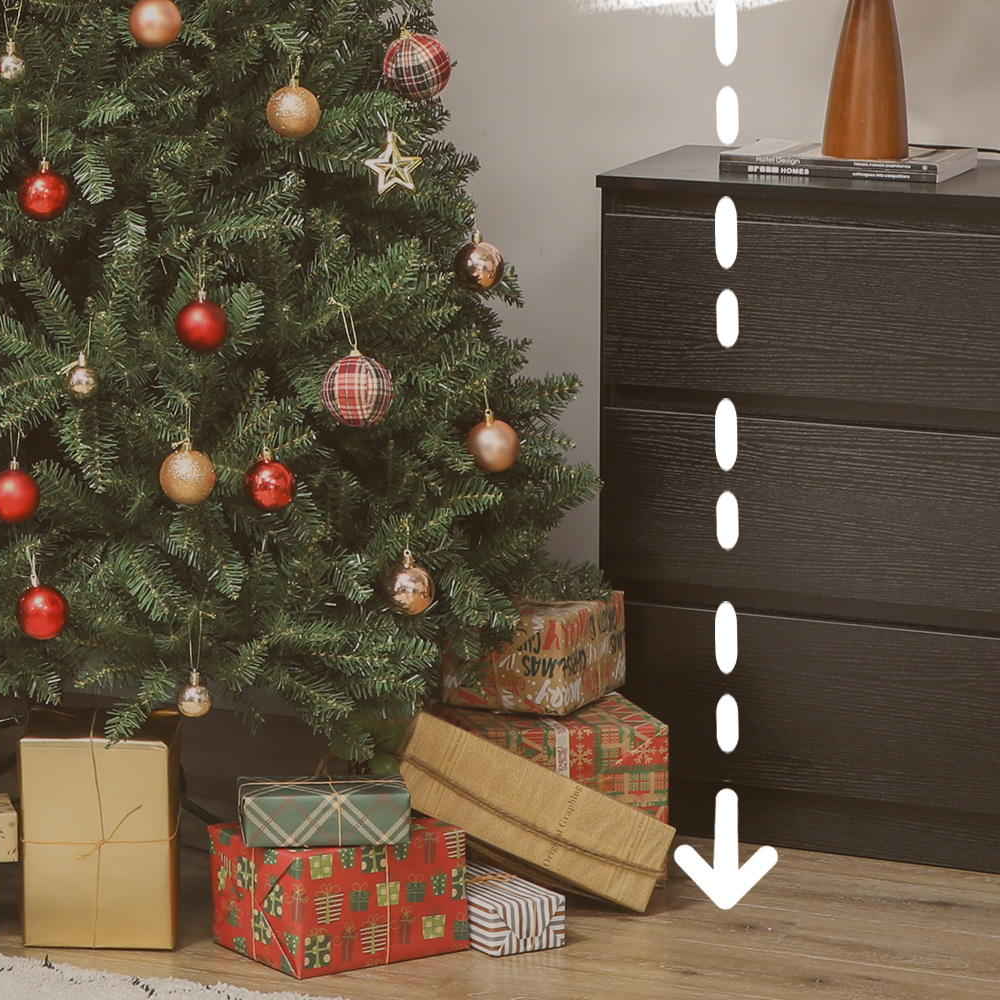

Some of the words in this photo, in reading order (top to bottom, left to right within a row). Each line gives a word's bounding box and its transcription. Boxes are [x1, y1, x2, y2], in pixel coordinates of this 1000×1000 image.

[756, 156, 775, 164] Hotel
[776, 157, 800, 165] Design
[780, 167, 810, 175] HOMES
[542, 829, 563, 868] Origial
[558, 785, 583, 829] Graphing
